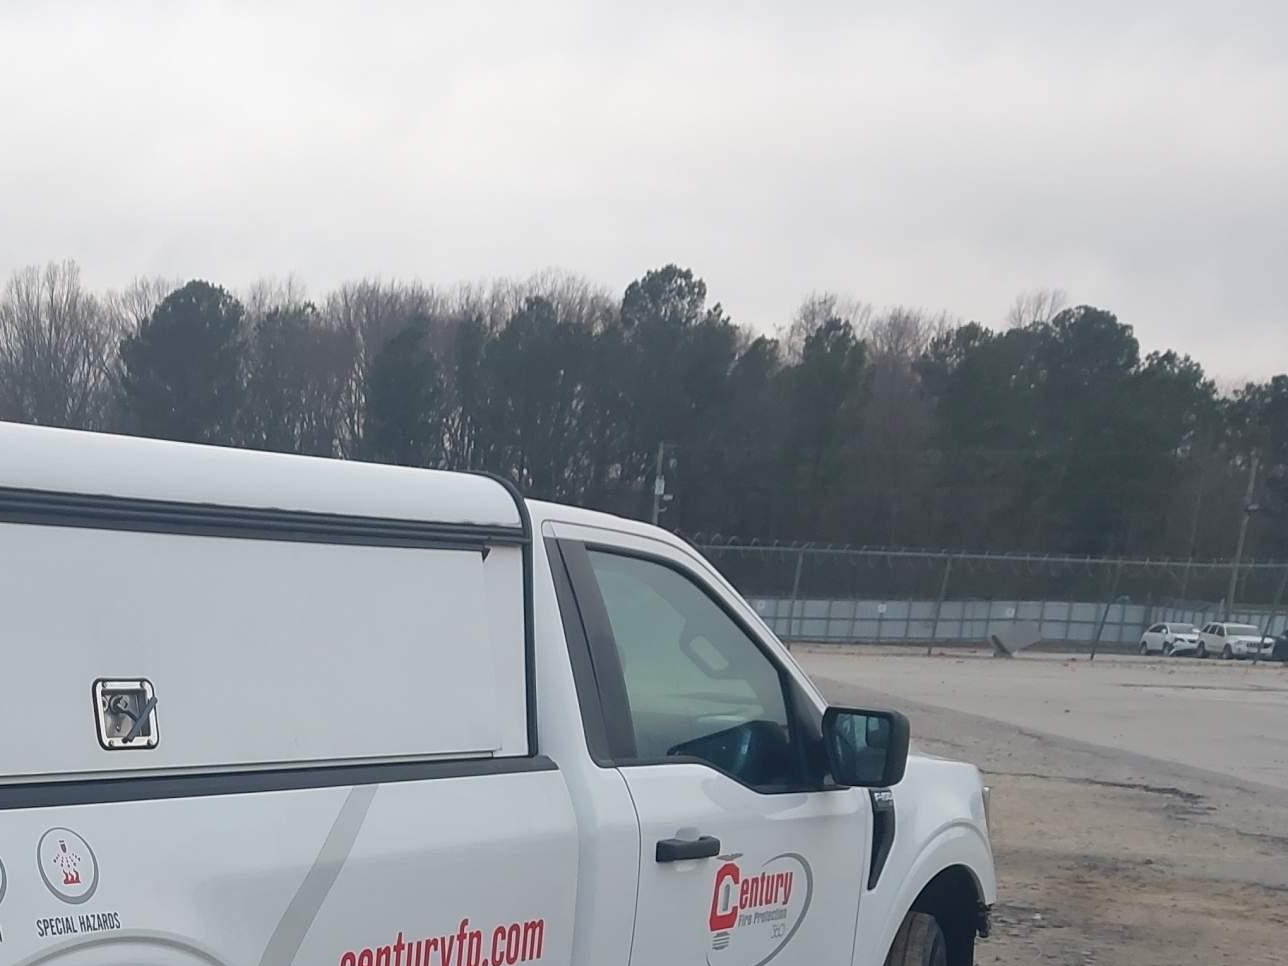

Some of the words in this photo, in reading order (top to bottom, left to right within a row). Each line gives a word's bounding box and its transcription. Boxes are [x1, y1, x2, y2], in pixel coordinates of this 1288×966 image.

[710, 863, 793, 932] Century
[36, 915, 78, 937] SPECIAL
[79, 912, 121, 932] HAZARDS
[738, 914, 752, 928] Fire
